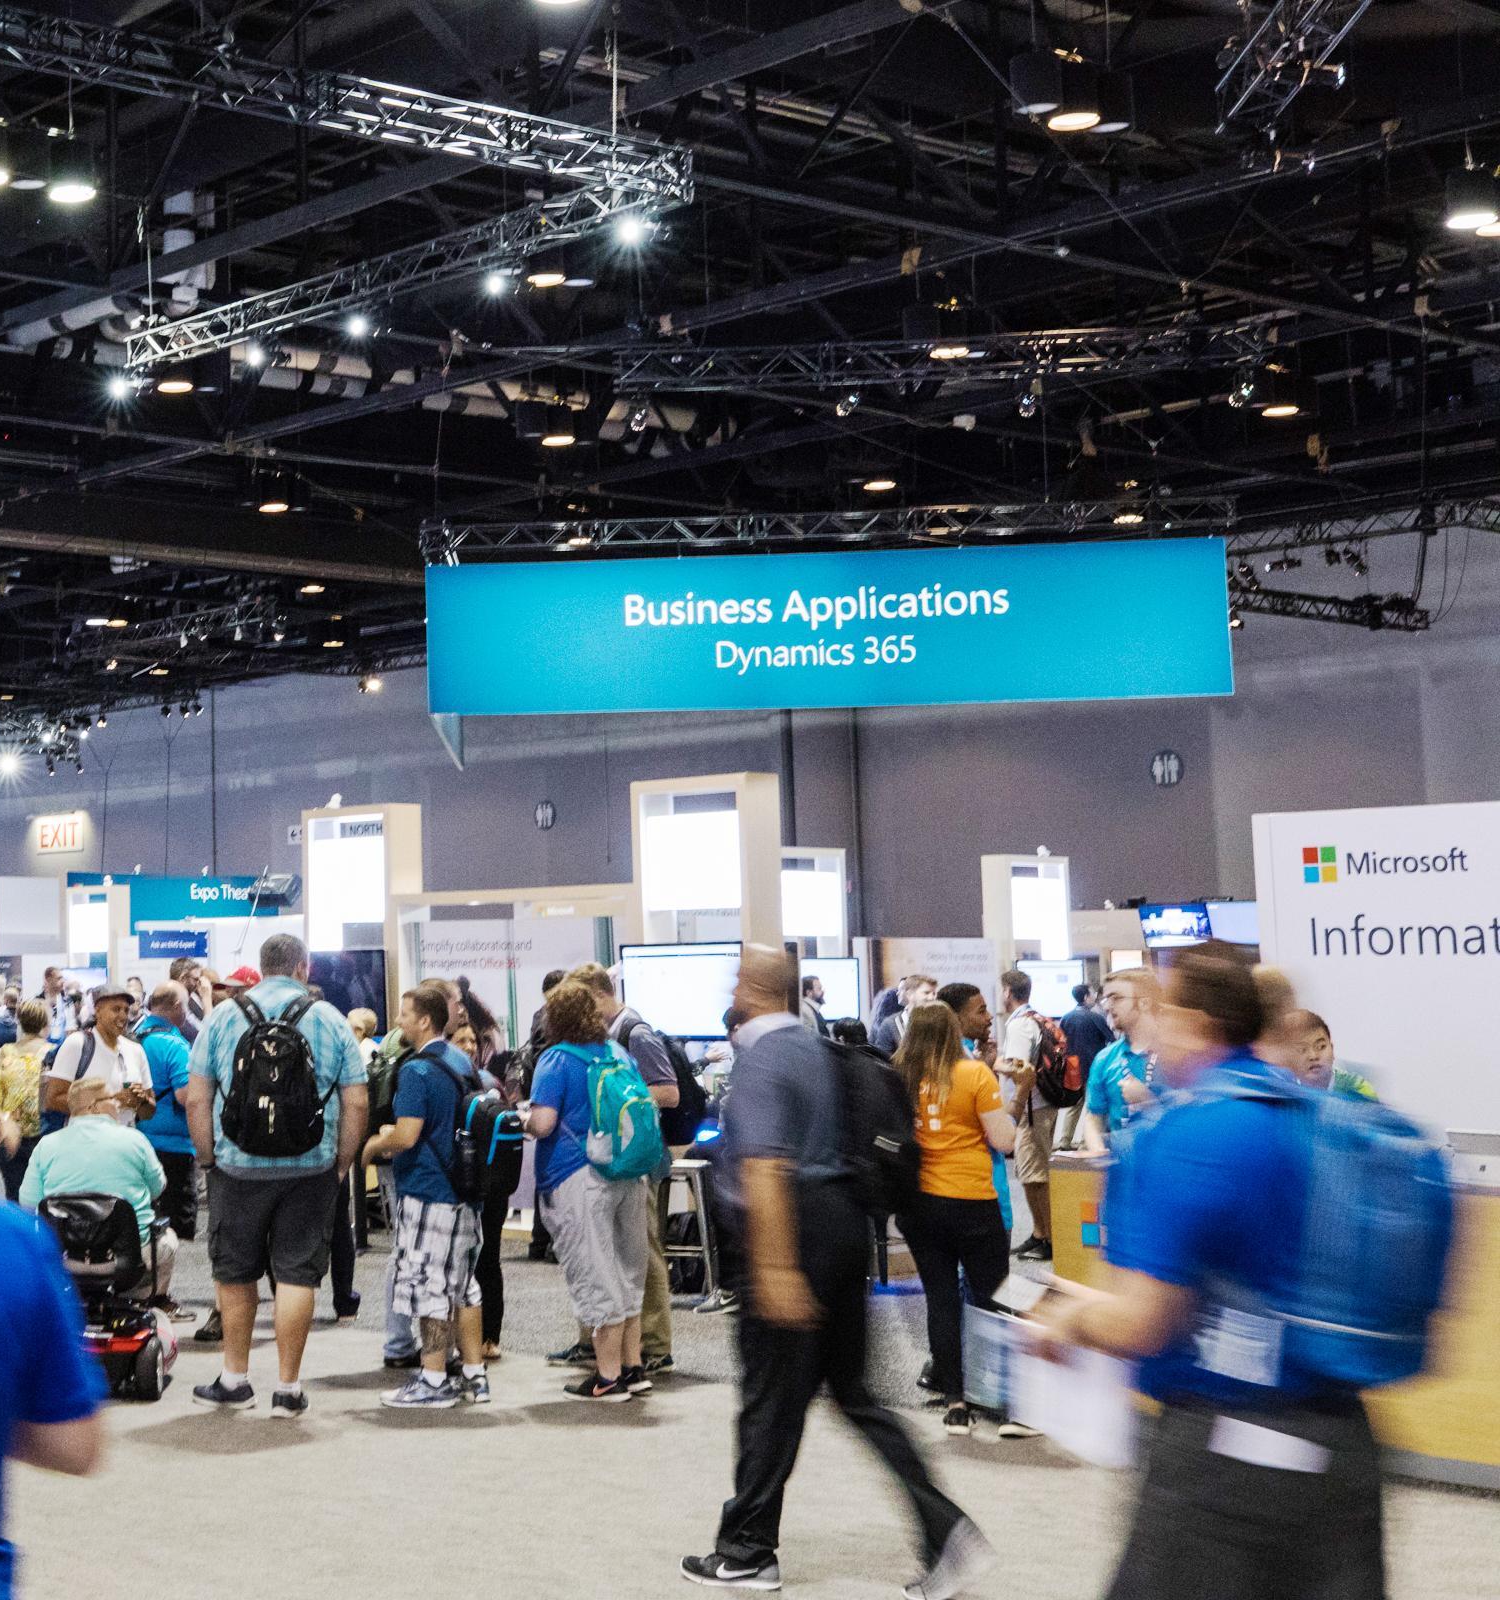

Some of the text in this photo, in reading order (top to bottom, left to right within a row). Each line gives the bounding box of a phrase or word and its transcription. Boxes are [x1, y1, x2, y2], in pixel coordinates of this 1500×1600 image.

[623, 583, 1010, 631] Business Applications
[715, 634, 917, 675] Dynamics 365
[40, 821, 79, 849] EXIT
[349, 823, 383, 837] NORTH
[1345, 847, 1469, 876] Microsoft
[190, 882, 220, 904] Expo
[419, 938, 532, 955] Simplify collaboration and
